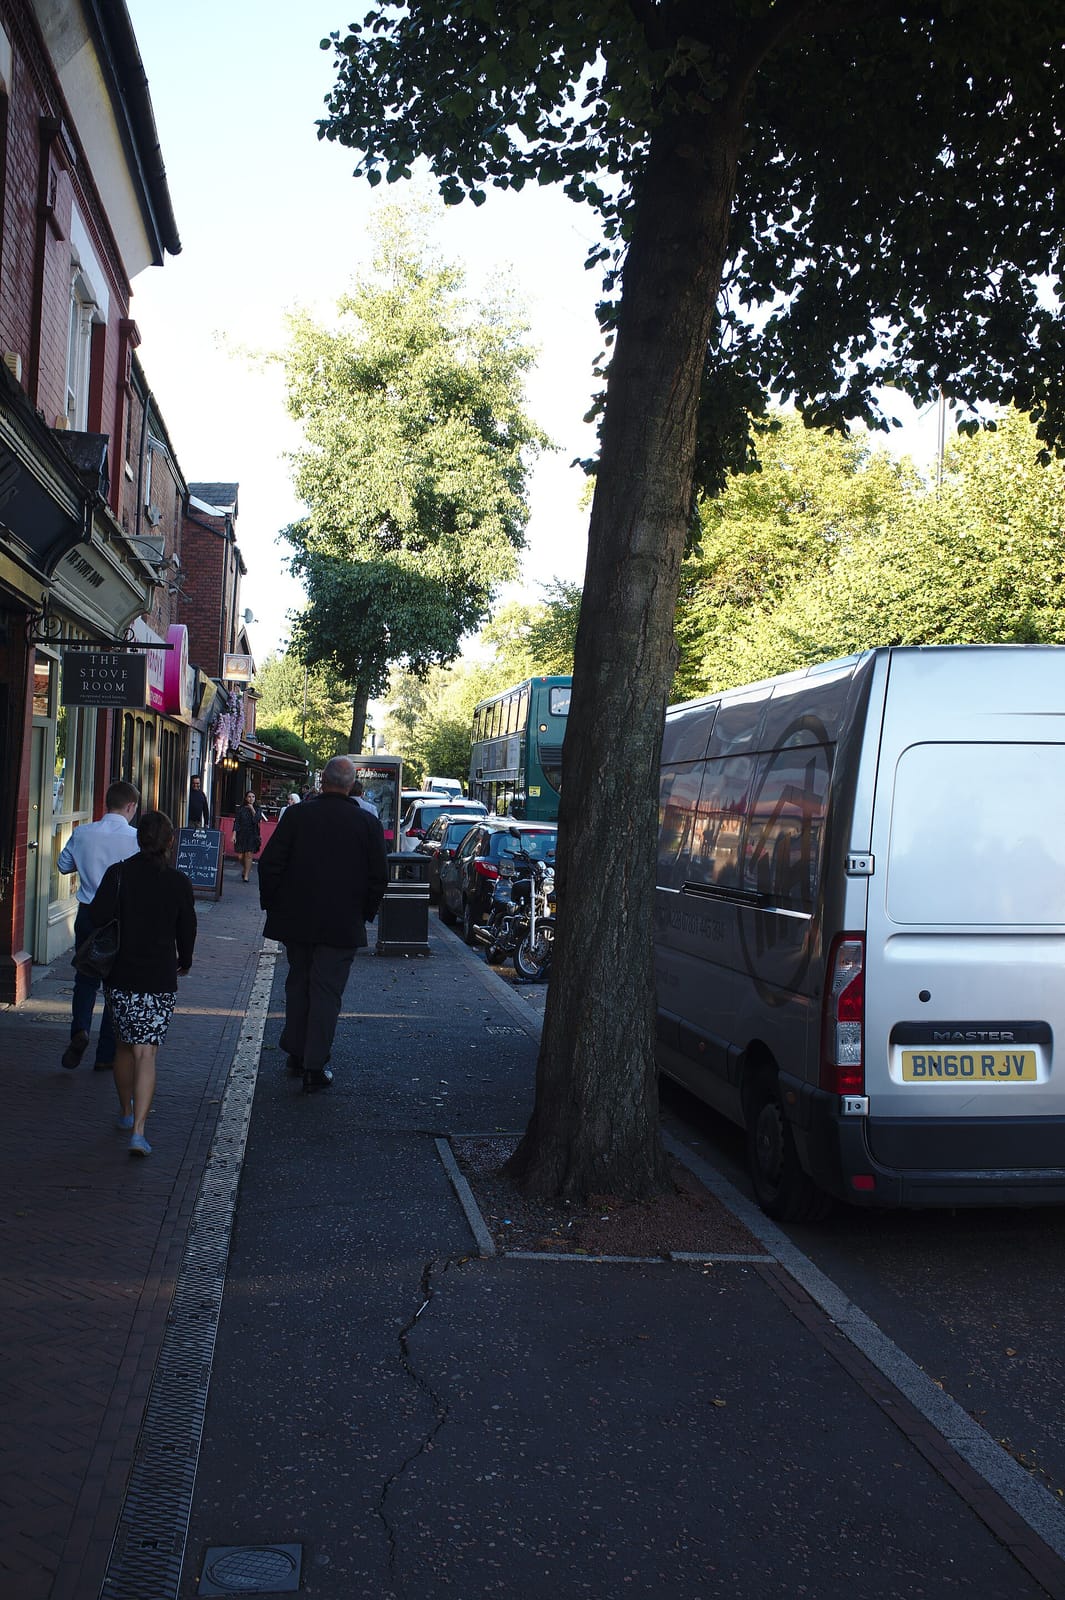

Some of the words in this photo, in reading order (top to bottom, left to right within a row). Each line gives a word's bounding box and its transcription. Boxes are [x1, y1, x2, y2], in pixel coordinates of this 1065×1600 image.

[90, 655, 119, 665] THE
[79, 668, 128, 679] STOVE
[82, 681, 125, 692] ROOM
[933, 1031, 1014, 1041] MASTER
[912, 1055, 973, 1077] BN60
[982, 1055, 1025, 1077] RJV
